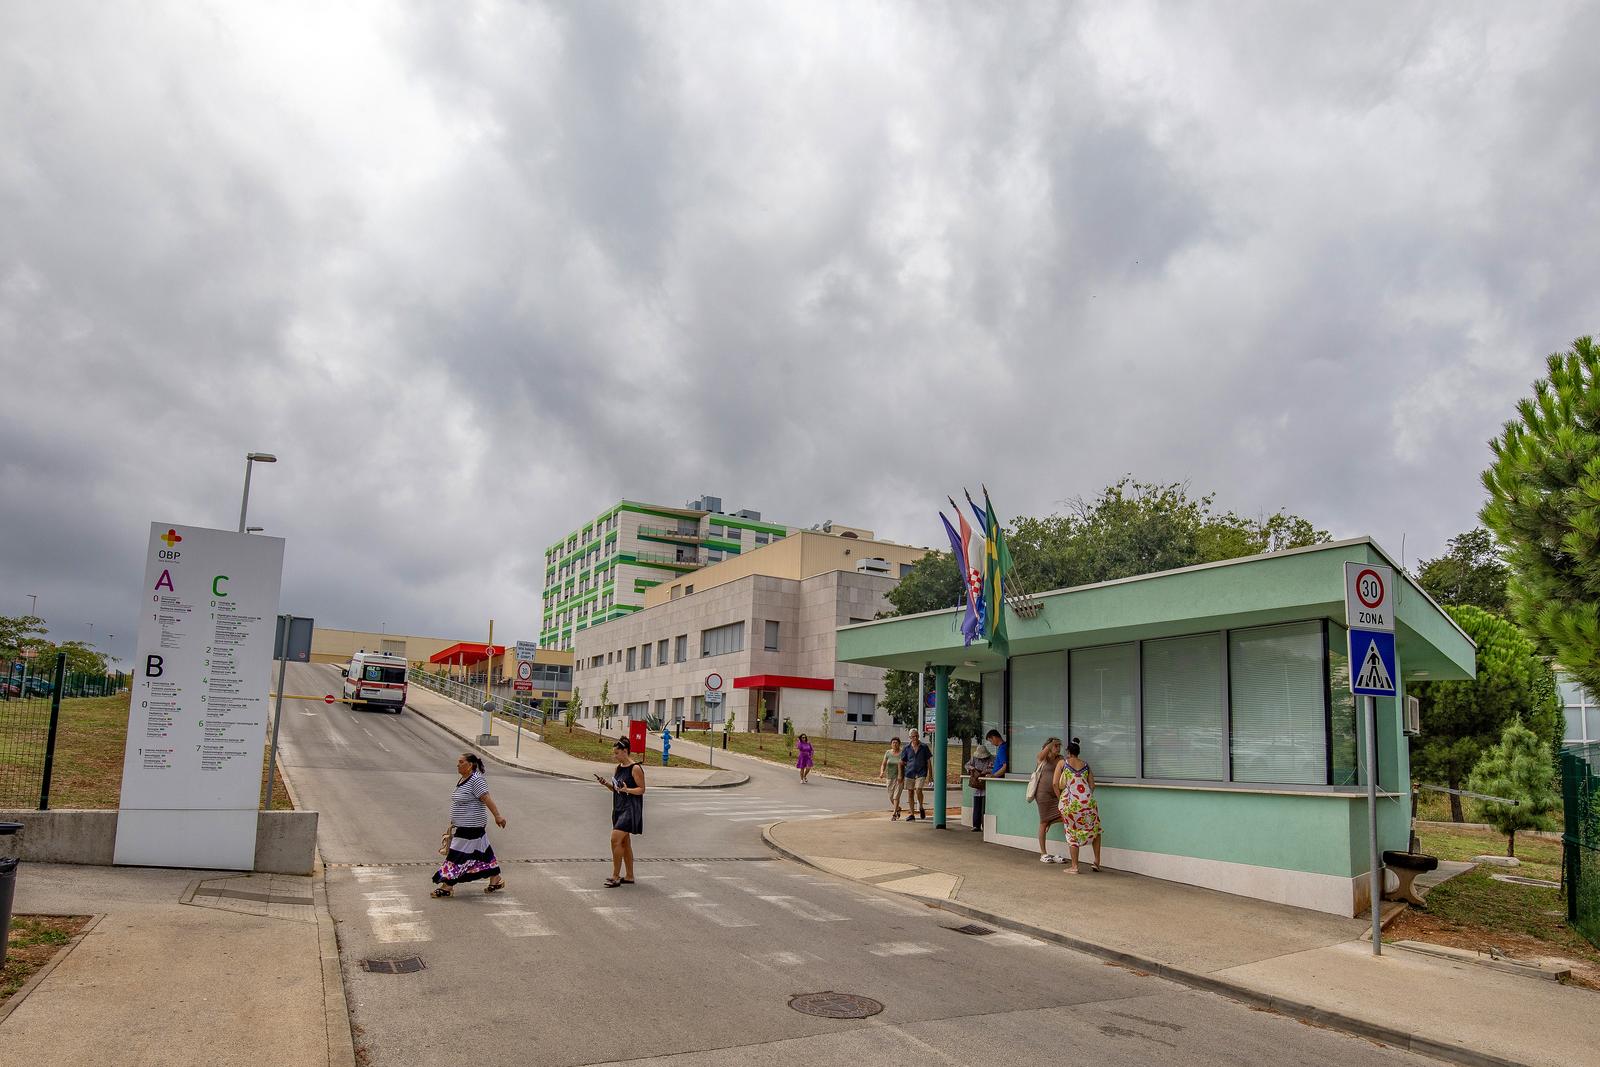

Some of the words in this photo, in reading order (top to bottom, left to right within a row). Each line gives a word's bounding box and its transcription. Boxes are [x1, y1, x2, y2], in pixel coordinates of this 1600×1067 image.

[158, 549, 181, 560] OBP
[154, 569, 174, 592] A
[212, 575, 229, 597] C
[1362, 579, 1378, 598] 30
[1359, 612, 1384, 625] ZONA
[146, 654, 164, 677] B
